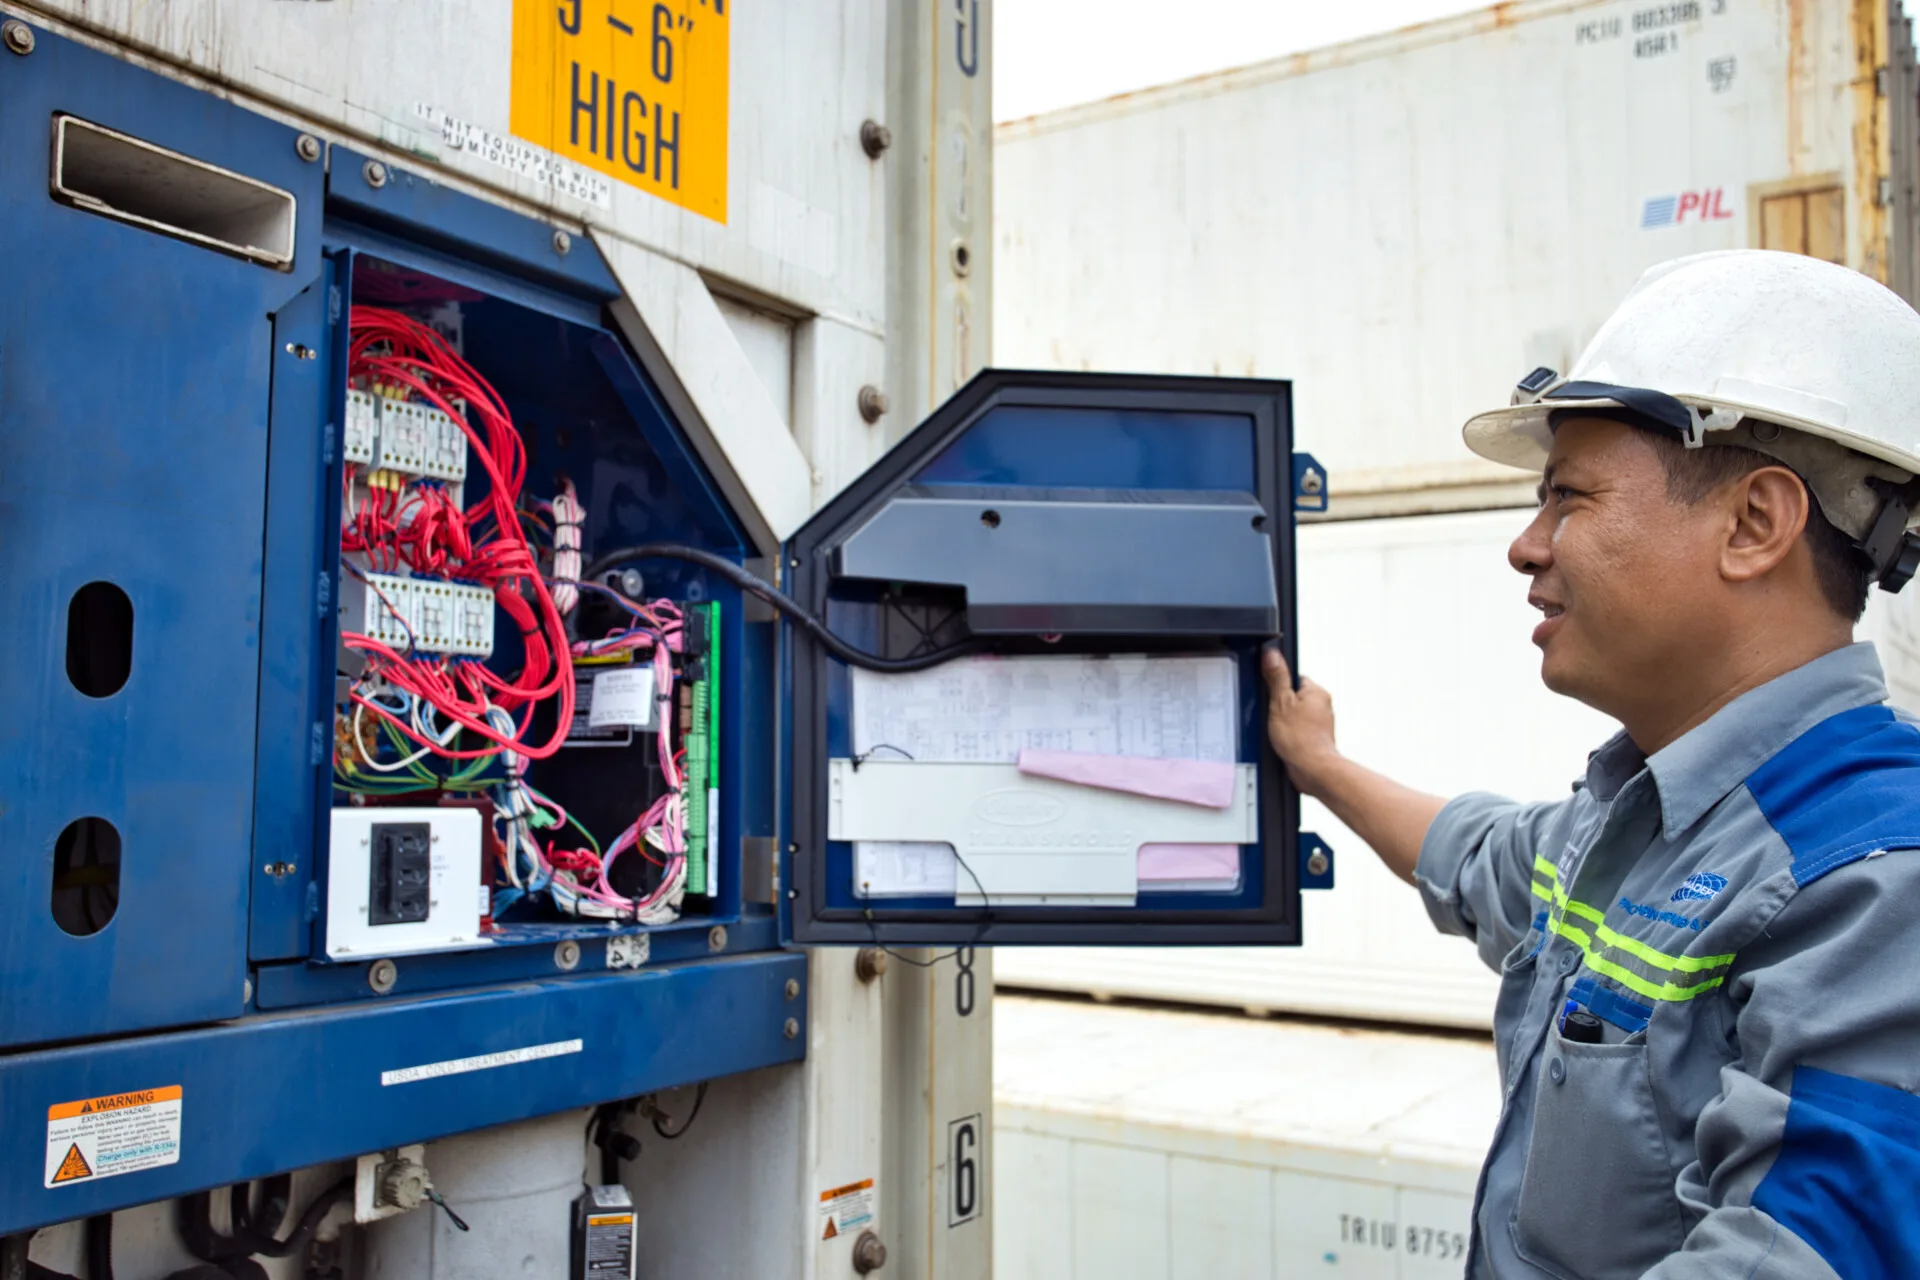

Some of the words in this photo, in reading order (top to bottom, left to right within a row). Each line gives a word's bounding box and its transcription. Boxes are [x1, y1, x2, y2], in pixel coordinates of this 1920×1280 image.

[570, 60, 680, 190] HIGH
[442, 127, 527, 172] HUMIDITY
[538, 170, 598, 201] SENSOR
[483, 132, 563, 174] EQUIPPED
[572, 171, 607, 194] WITH
[1676, 186, 1734, 224] PIL
[82, 1111, 121, 1123] EXPLOSION
[124, 1104, 151, 1116] HAZARD
[96, 1091, 154, 1111] WARNING
[98, 1153, 122, 1162] Charge
[124, 1149, 137, 1157] only
[956, 1124, 975, 1216] 6
[1339, 1213, 1397, 1250] TRIU
